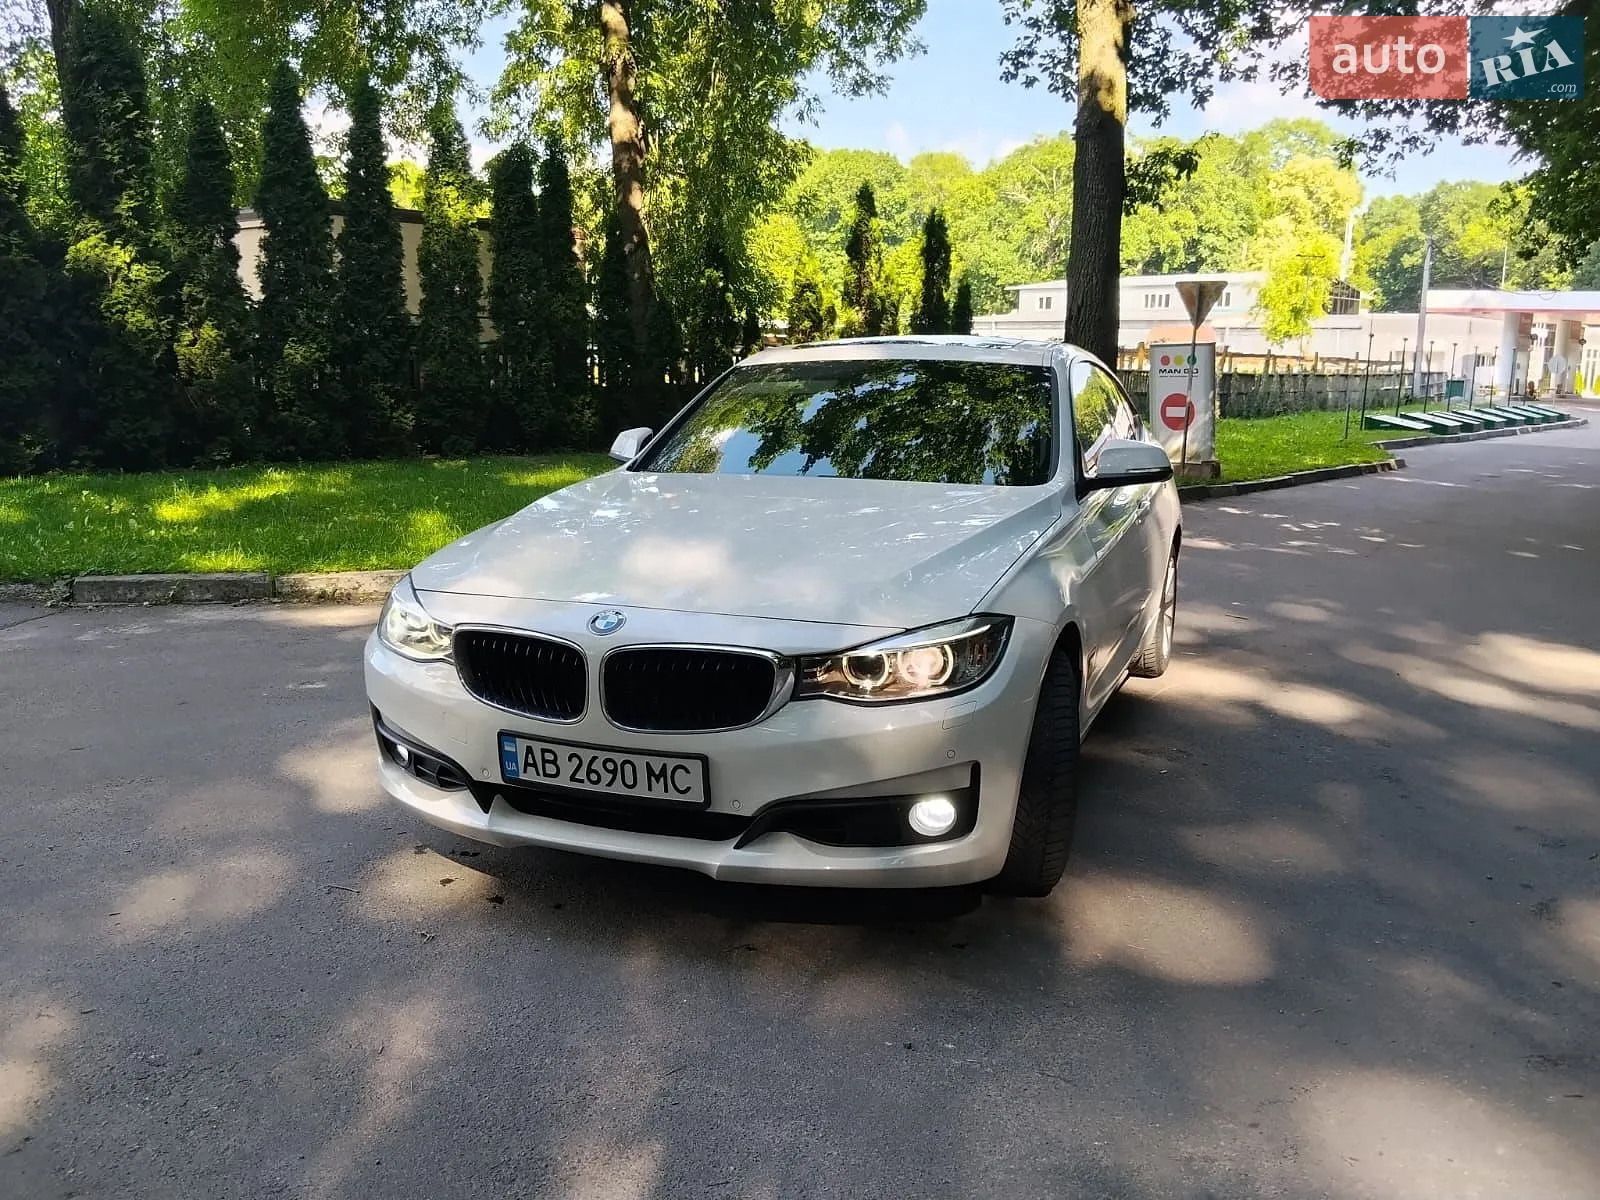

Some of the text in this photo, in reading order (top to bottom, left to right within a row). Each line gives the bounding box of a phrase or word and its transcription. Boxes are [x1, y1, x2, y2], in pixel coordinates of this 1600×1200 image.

[505, 760, 517, 771] UA
[523, 745, 692, 795] AB 2690 MC
